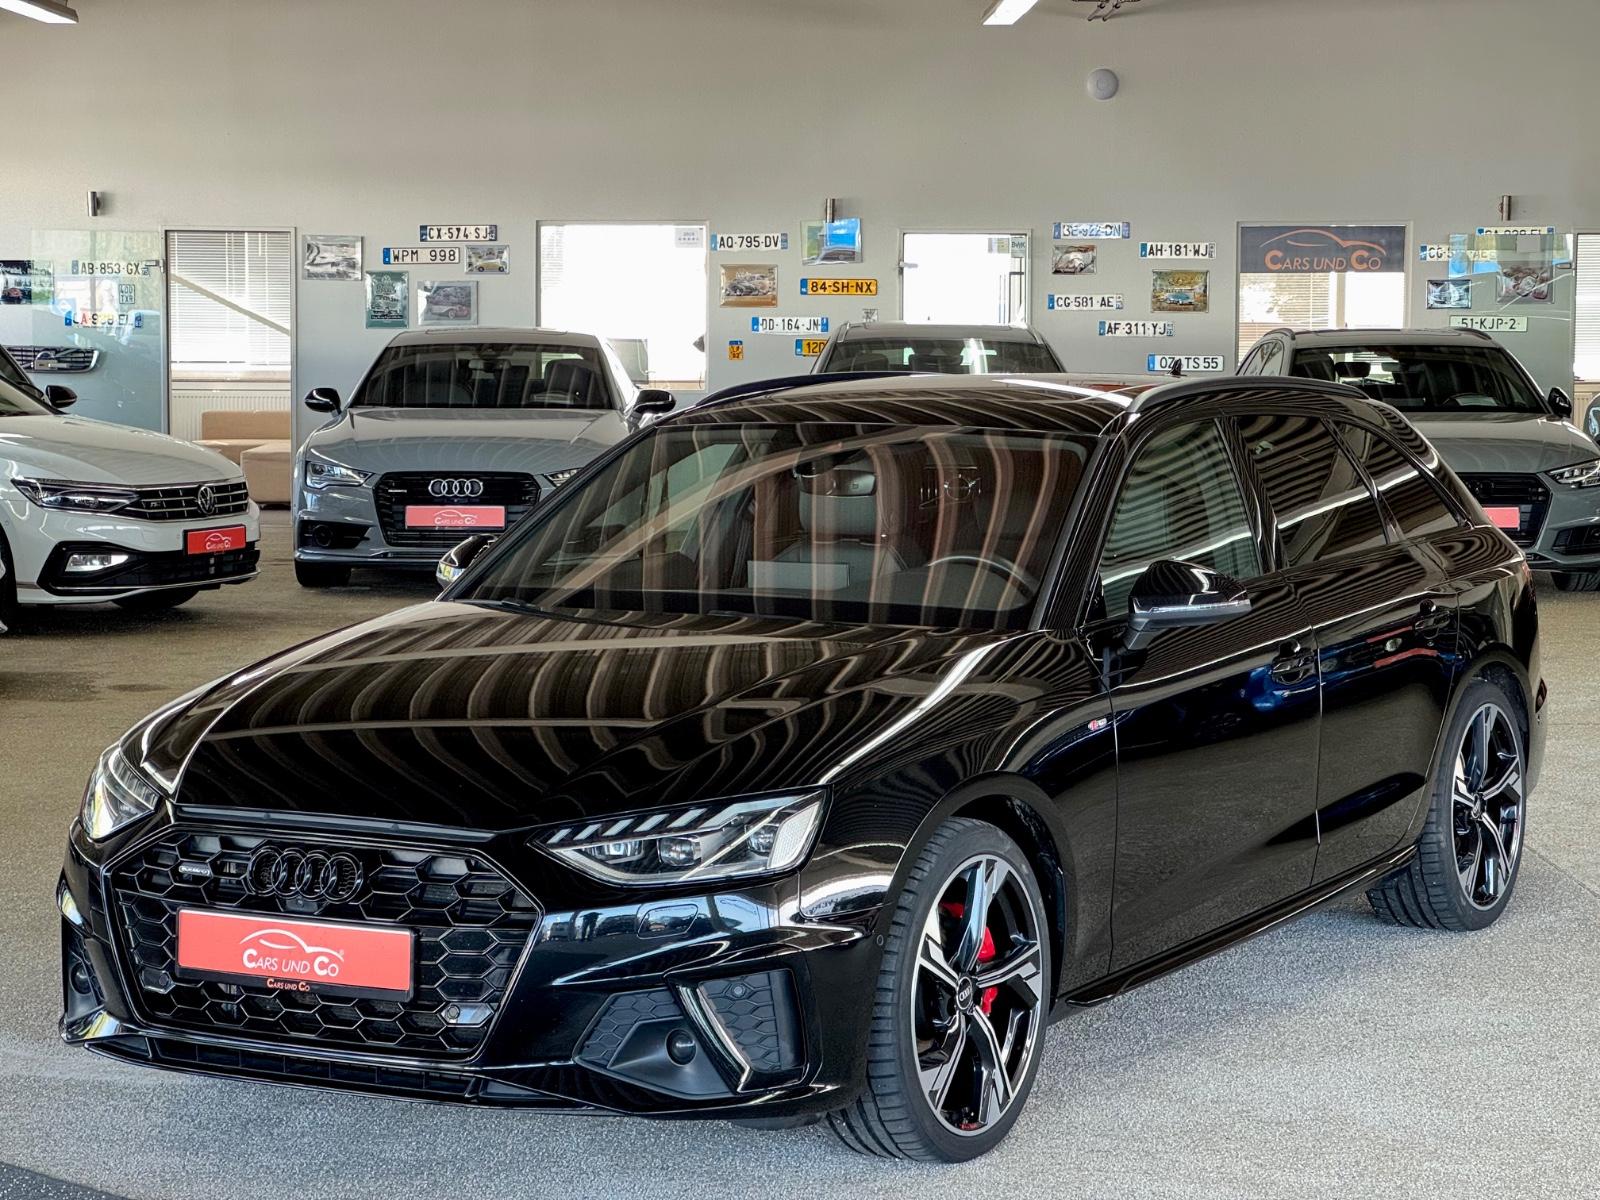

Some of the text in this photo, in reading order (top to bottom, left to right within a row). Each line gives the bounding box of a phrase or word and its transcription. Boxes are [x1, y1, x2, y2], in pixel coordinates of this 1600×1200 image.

[719, 236, 779, 248] AQ-795-DV
[392, 249, 456, 262] WPM 998
[1148, 244, 1208, 257] AH-181-WJ
[1264, 250, 1381, 270] CARS UND CO
[81, 262, 140, 275] AB-853-GX
[810, 281, 873, 293] 84-SH-NX
[1056, 297, 1114, 308] CG-581-AE
[1458, 317, 1517, 330] 51-KJP-2
[1184, 357, 1200, 370] TS
[1203, 357, 1218, 370] 55
[243, 948, 339, 977] CARS UND CO
[266, 978, 284, 990] CARS
